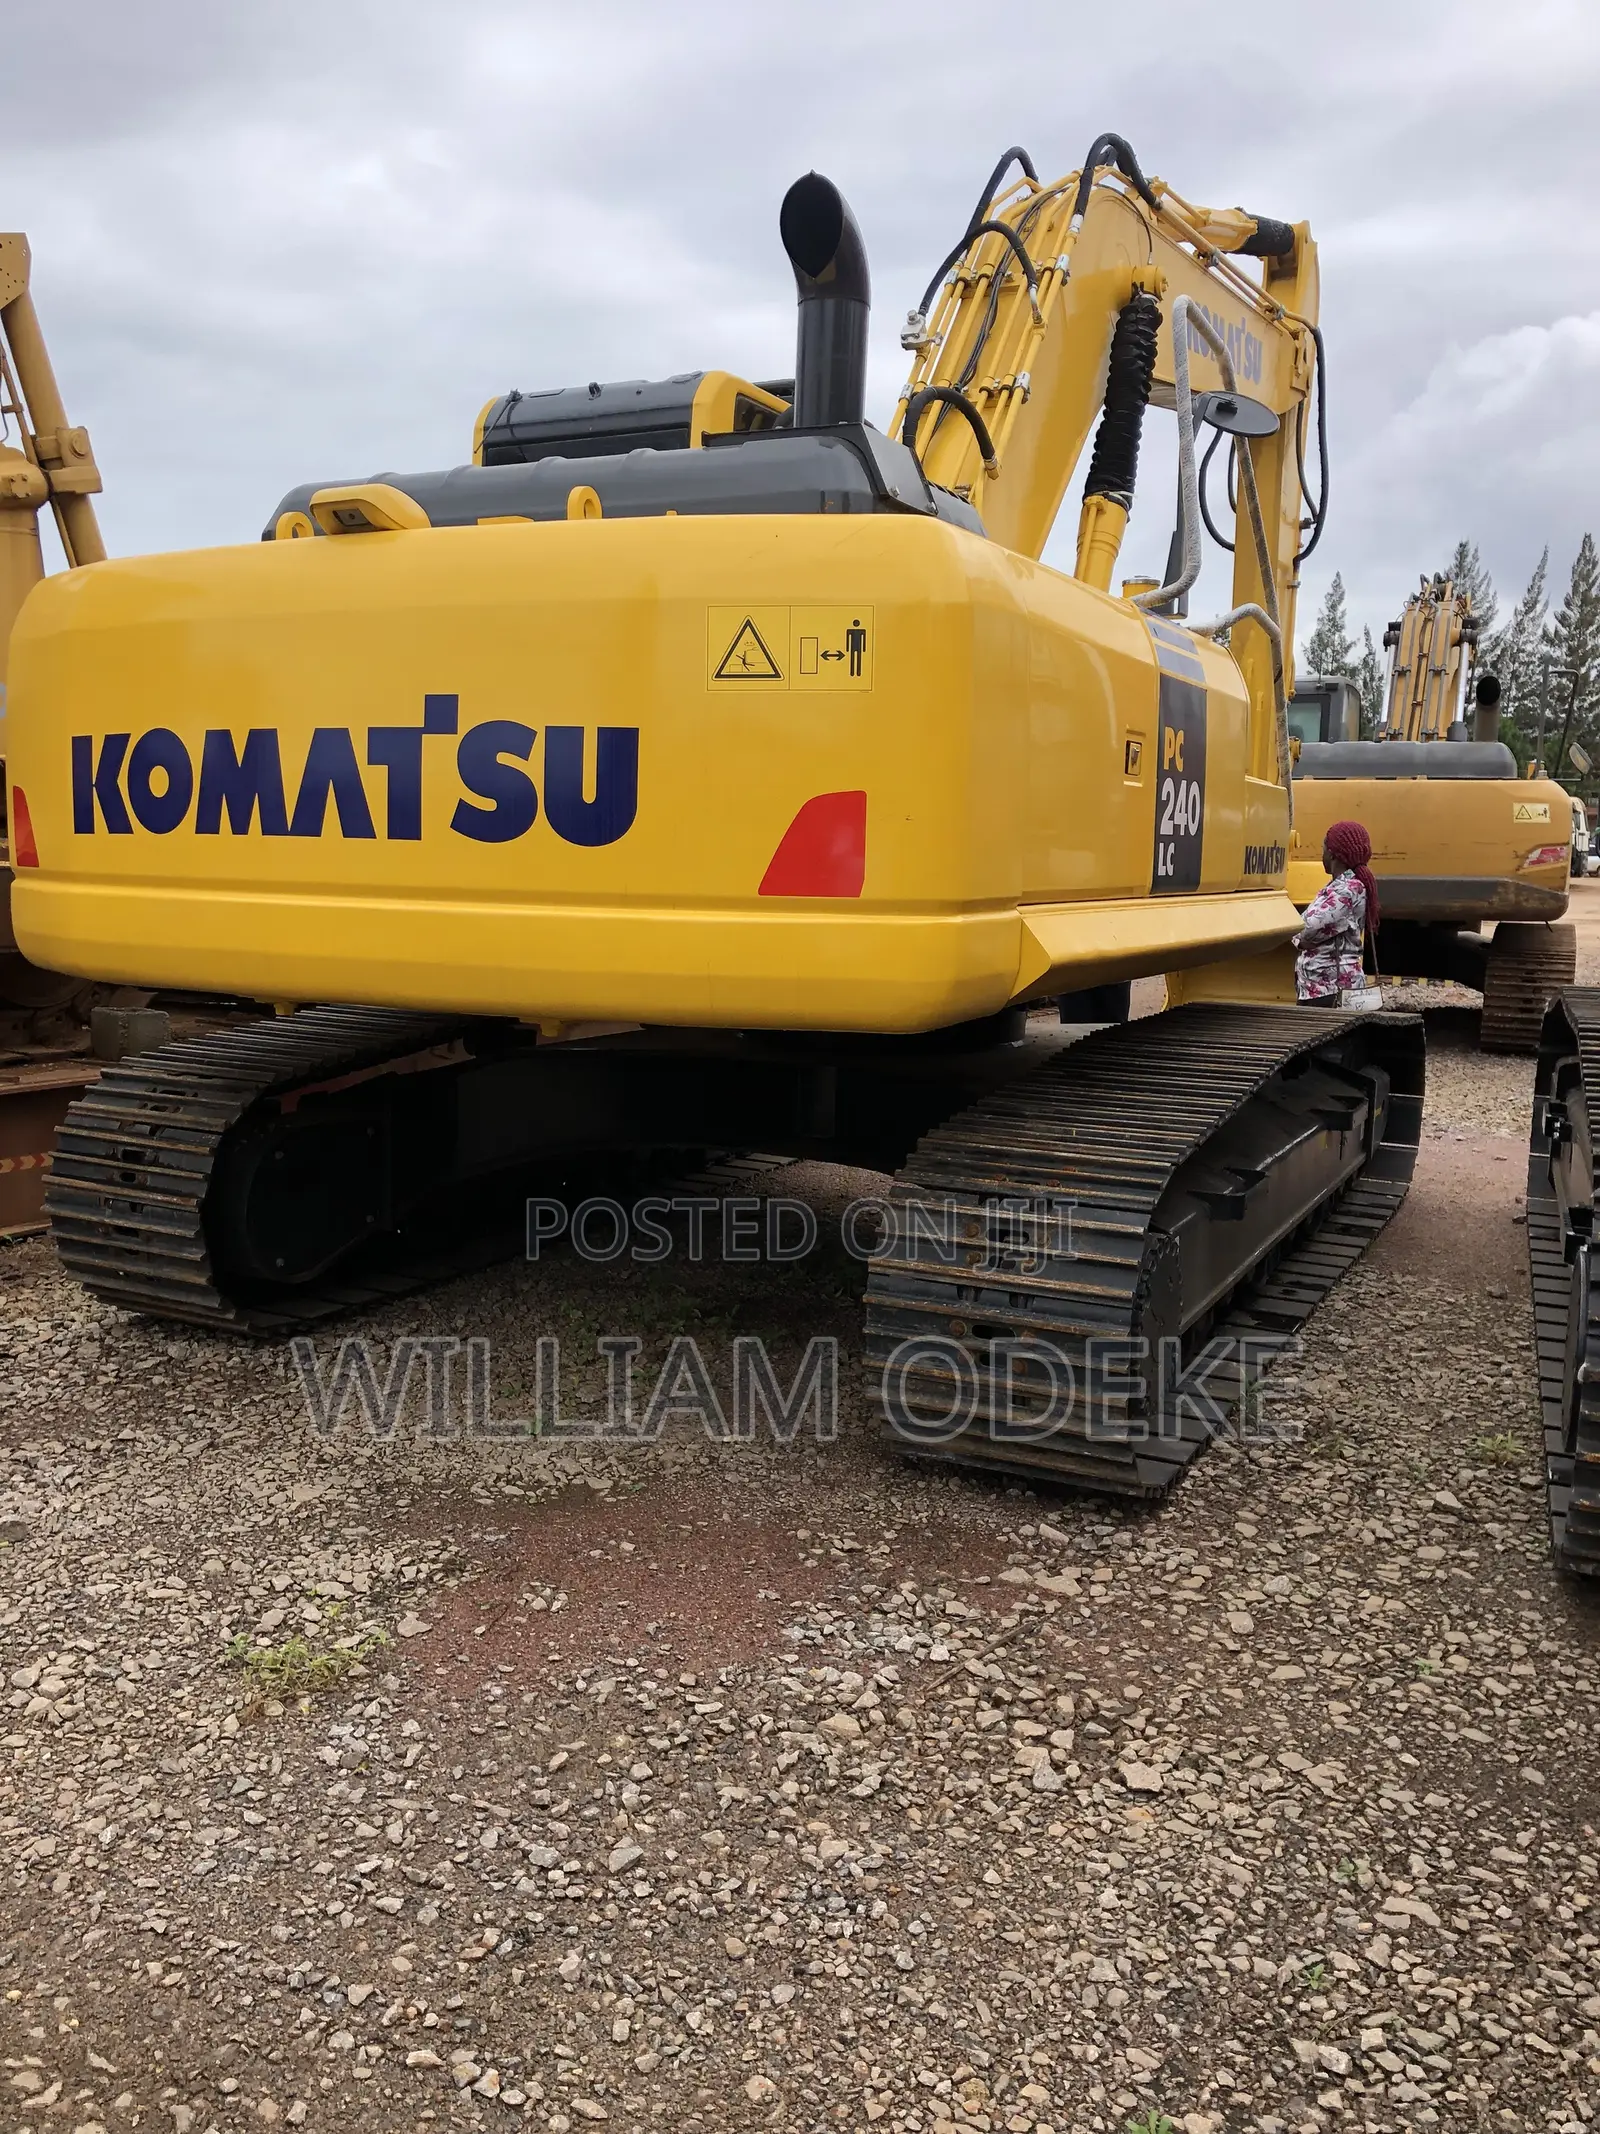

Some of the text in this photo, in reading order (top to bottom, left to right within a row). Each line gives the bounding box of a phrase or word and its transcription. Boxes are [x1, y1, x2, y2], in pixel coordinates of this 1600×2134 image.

[72, 694, 639, 847] KOMATSU
[1164, 727, 1184, 772] PC
[1160, 777, 1200, 836] 240
[1158, 842, 1175, 876] LC
[1244, 840, 1285, 874] KOMATSU
